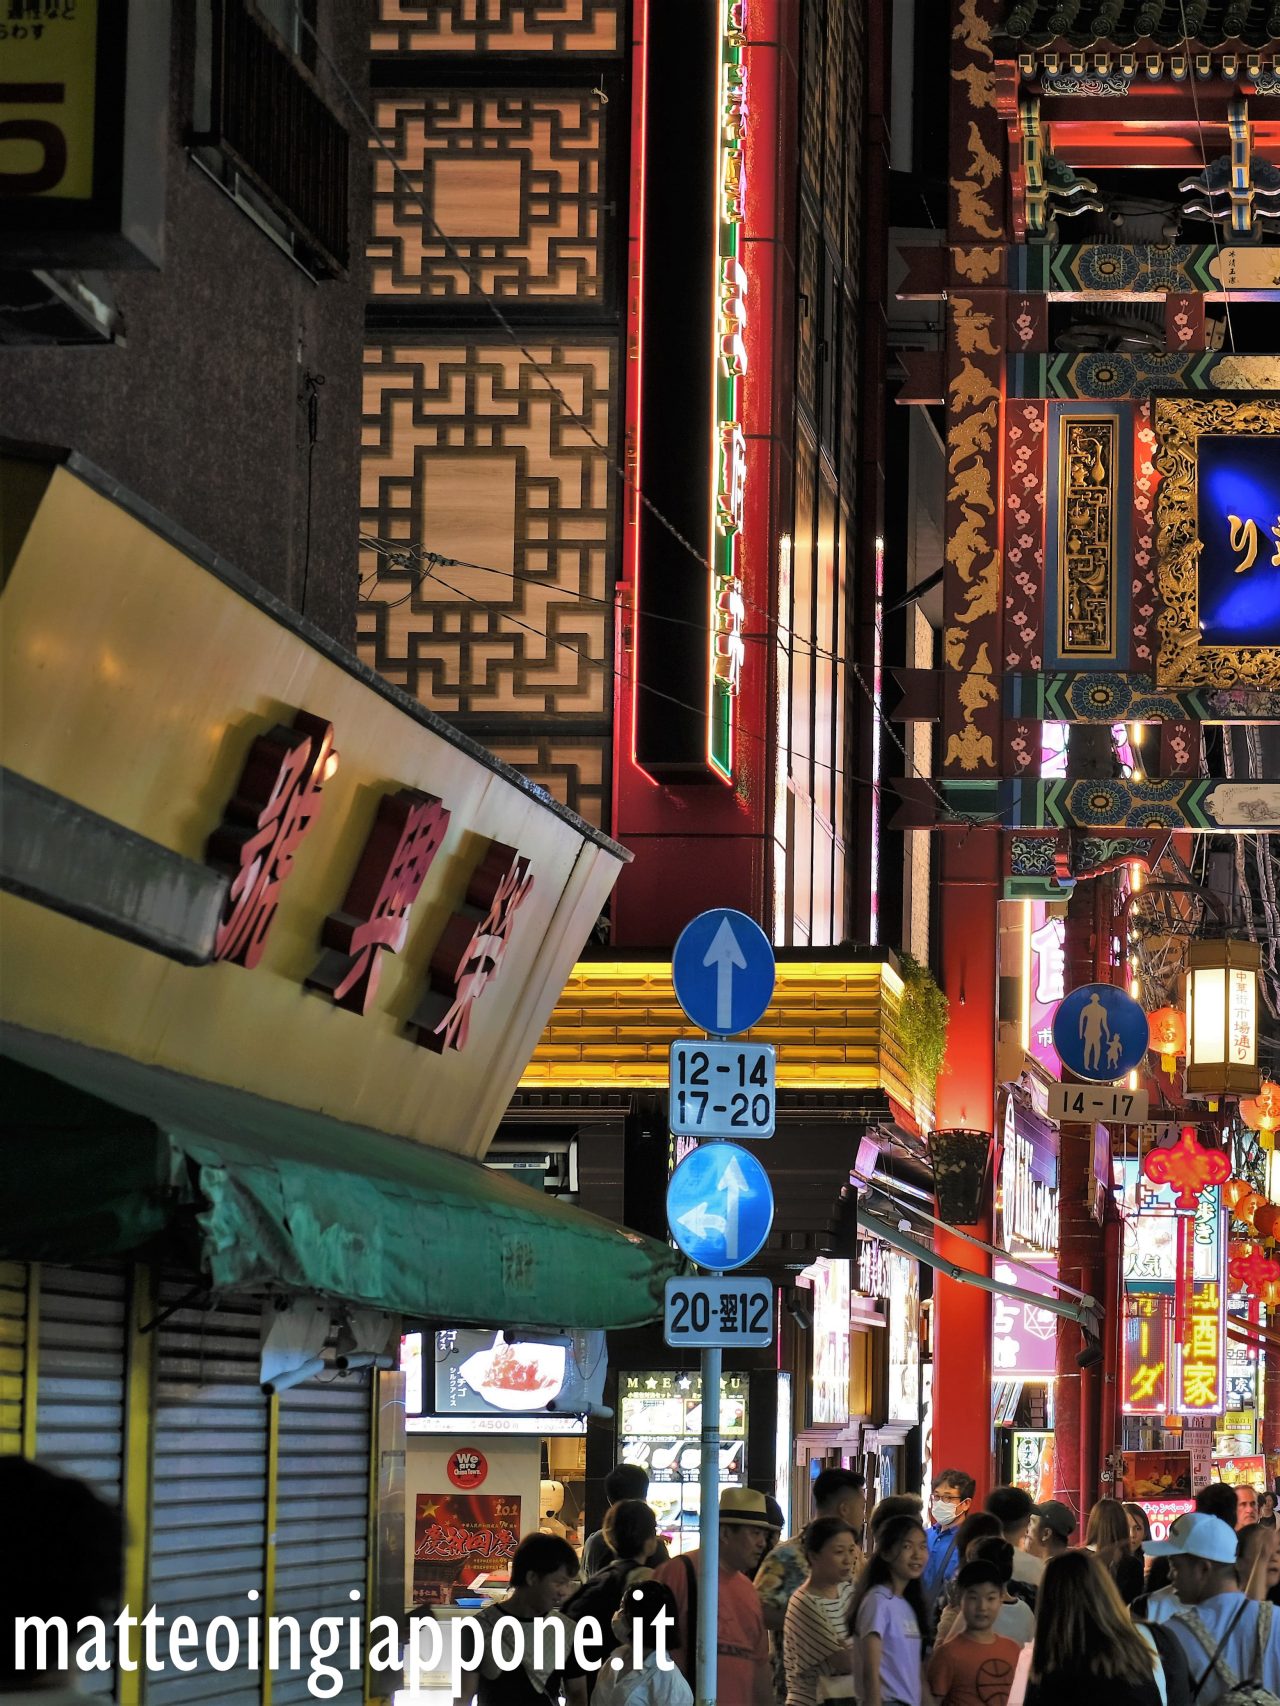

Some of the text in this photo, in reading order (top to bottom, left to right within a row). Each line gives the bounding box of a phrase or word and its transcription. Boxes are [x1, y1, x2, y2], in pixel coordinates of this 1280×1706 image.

[1233, 971, 1251, 1060] 中華街市場通り
[1125, 1253, 1162, 1278] 人気
[670, 1291, 769, 1334] 20-翌12
[456, 1453, 479, 1464] We
